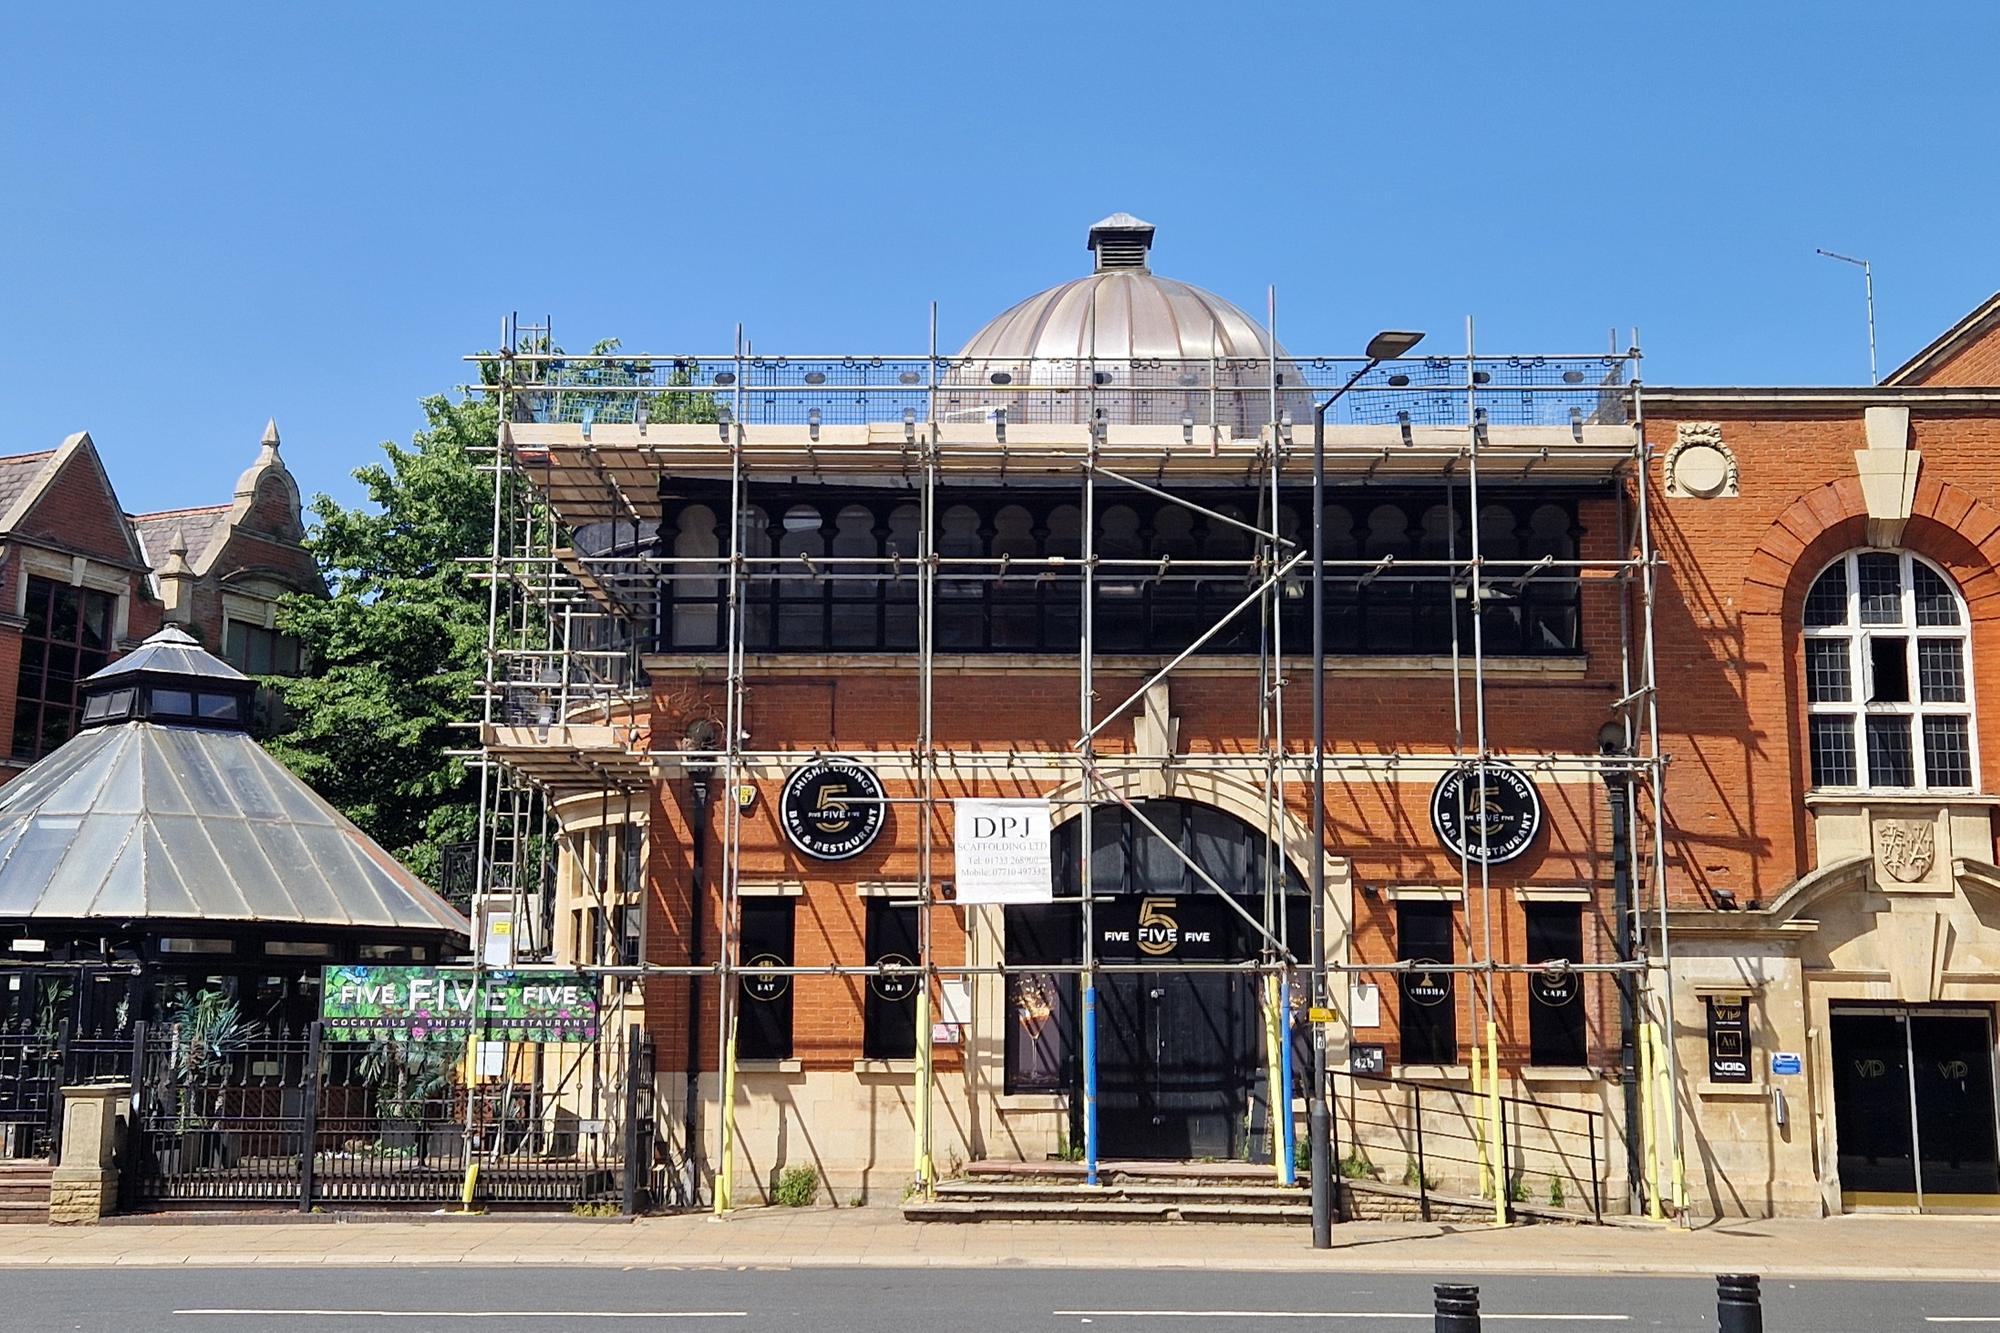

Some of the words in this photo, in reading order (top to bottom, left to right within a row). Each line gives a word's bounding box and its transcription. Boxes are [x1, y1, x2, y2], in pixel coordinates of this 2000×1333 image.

[792, 766, 830, 797] SHISHA
[833, 766, 875, 795] LOUNGE
[1485, 769, 1529, 799] LOUNGE
[823, 811, 846, 819] FIVE
[1476, 814, 1499, 822] FVE
[789, 810, 804, 835] BAR
[802, 834, 812, 845] &
[813, 807, 878, 853] RESTAURANT
[972, 816, 1030, 838] DPJ
[1441, 812, 1457, 838] BAR
[1468, 812, 1533, 857] RESTAURANT
[957, 842, 1027, 851] SCAFFOLDING
[1029, 842, 1048, 851] LTD
[1104, 931, 1130, 941] FIVE
[1138, 928, 1178, 942] FIVE
[1184, 932, 1210, 942] FIVE
[884, 984, 903, 992] BAR
[341, 985, 396, 1004] FIVE
[408, 979, 507, 1012] FIVE
[523, 986, 577, 1004] FIVE
[332, 1019, 406, 1027] COCKTAILS
[502, 1019, 589, 1027] RESTAURANT
[1354, 1057, 1375, 1070] 42b
[1714, 1061, 1746, 1072] VOID
